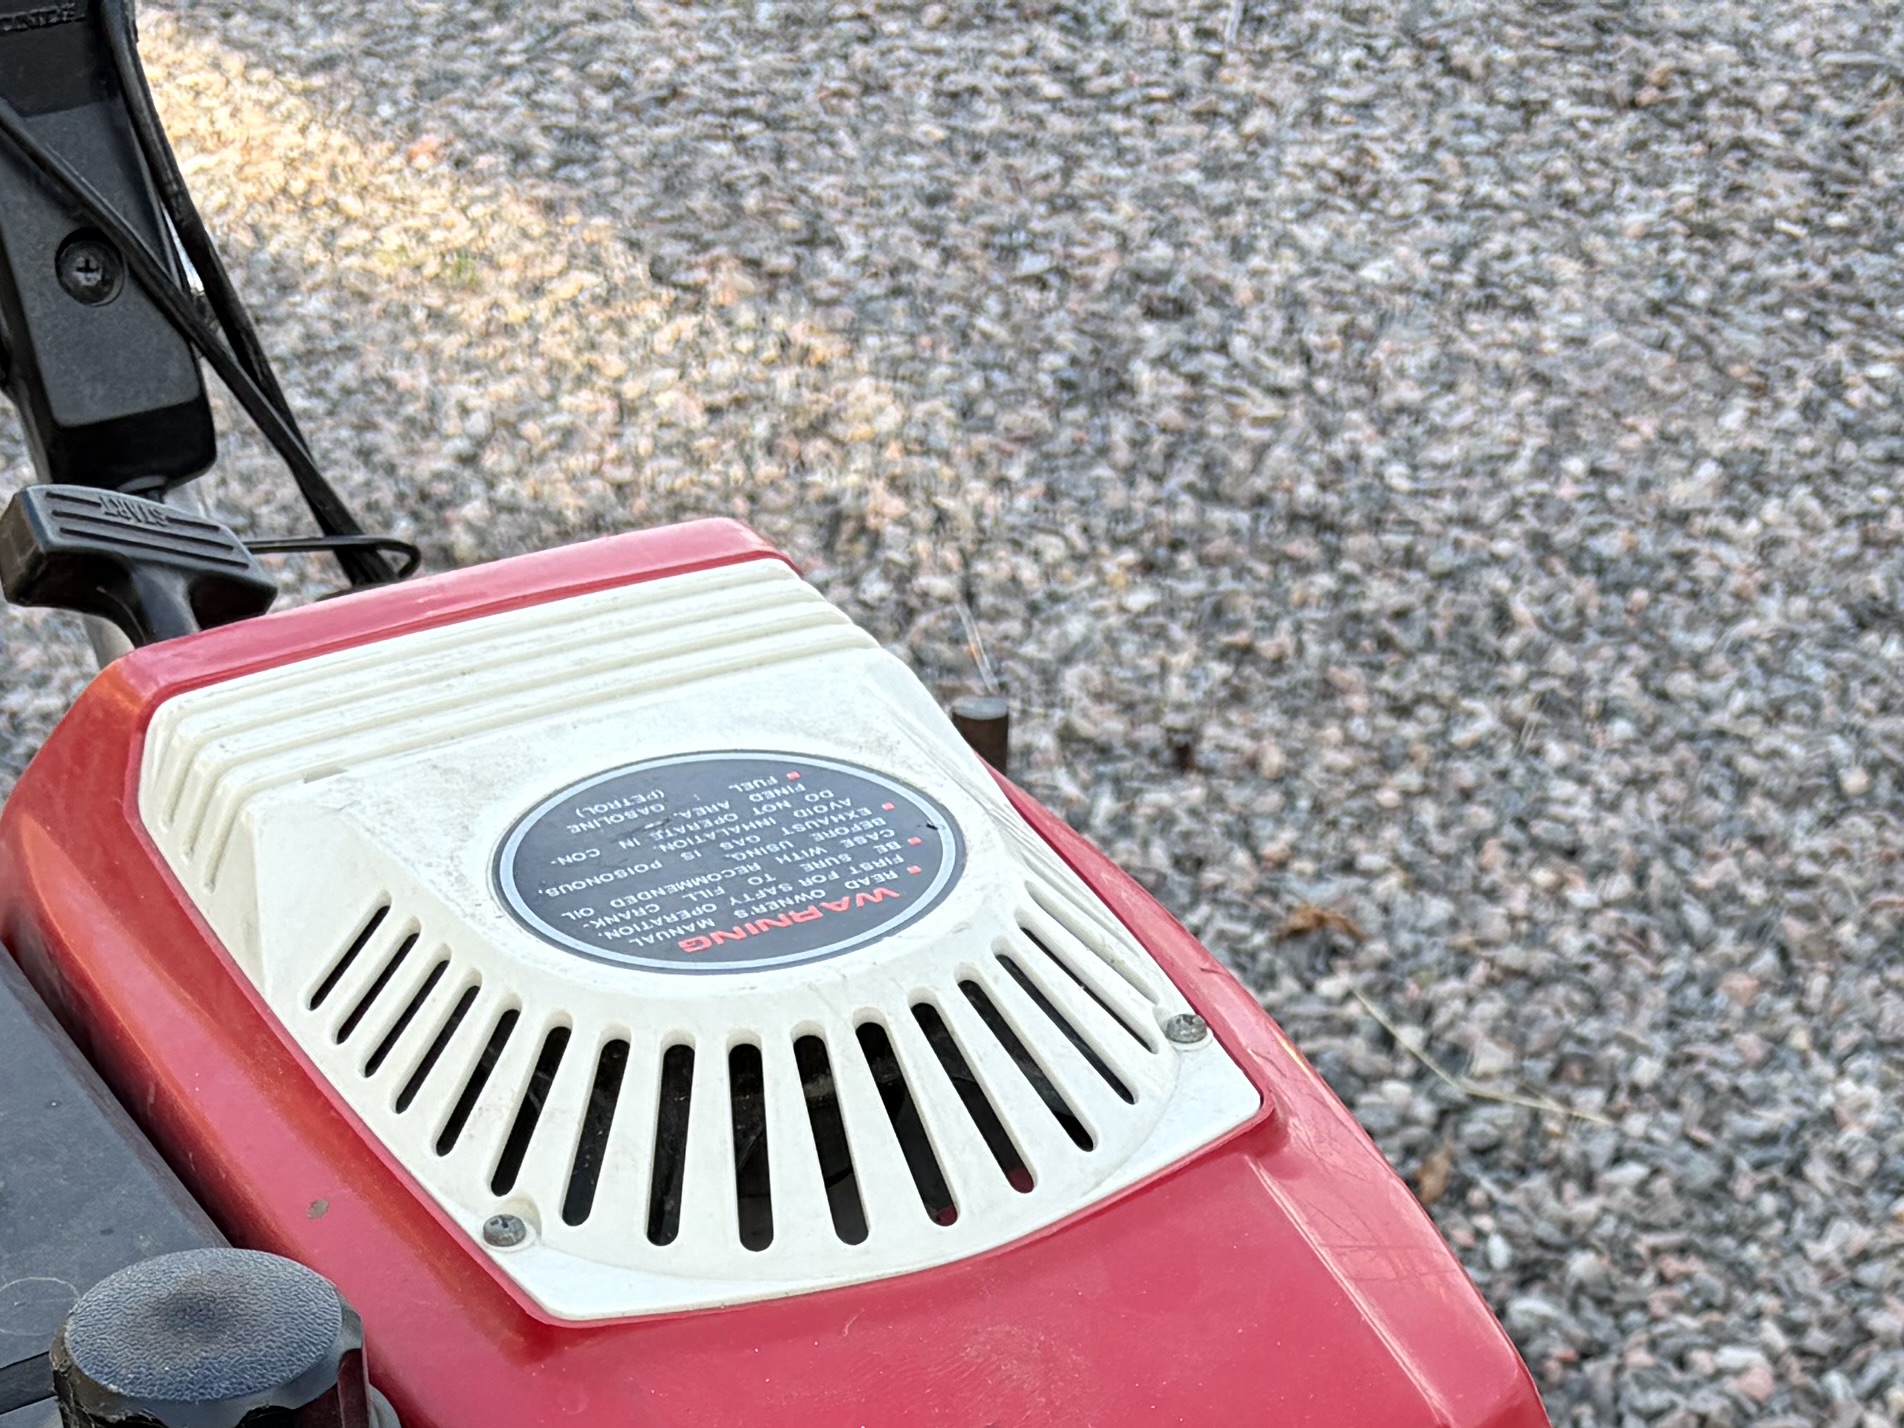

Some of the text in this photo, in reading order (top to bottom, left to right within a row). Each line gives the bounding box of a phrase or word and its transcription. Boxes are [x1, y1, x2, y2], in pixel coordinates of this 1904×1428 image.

[98, 495, 168, 528] START
[728, 776, 778, 792] FUEL
[749, 784, 806, 802] FINED
[576, 790, 664, 817] (PETROL)
[793, 798, 851, 818] AVOID
[551, 790, 834, 866] DO NOT OPERATE IN CON-
[566, 804, 665, 833] GASOLINE
[782, 808, 872, 836] EXHAUST
[810, 817, 886, 842] BEFORE
[681, 850, 702, 861] IS
[720, 835, 760, 850] GAS
[561, 829, 894, 920] CASE WITH RECOMMENDED OIL
[850, 854, 904, 874] FIRST
[582, 841, 902, 930] BE SURE TO FILL CRANK-
[798, 871, 839, 887] FOR
[730, 883, 792, 906] SAFTY
[629, 870, 898, 946] READ OWNER'S MANUAL
[678, 888, 900, 952] WARNING
